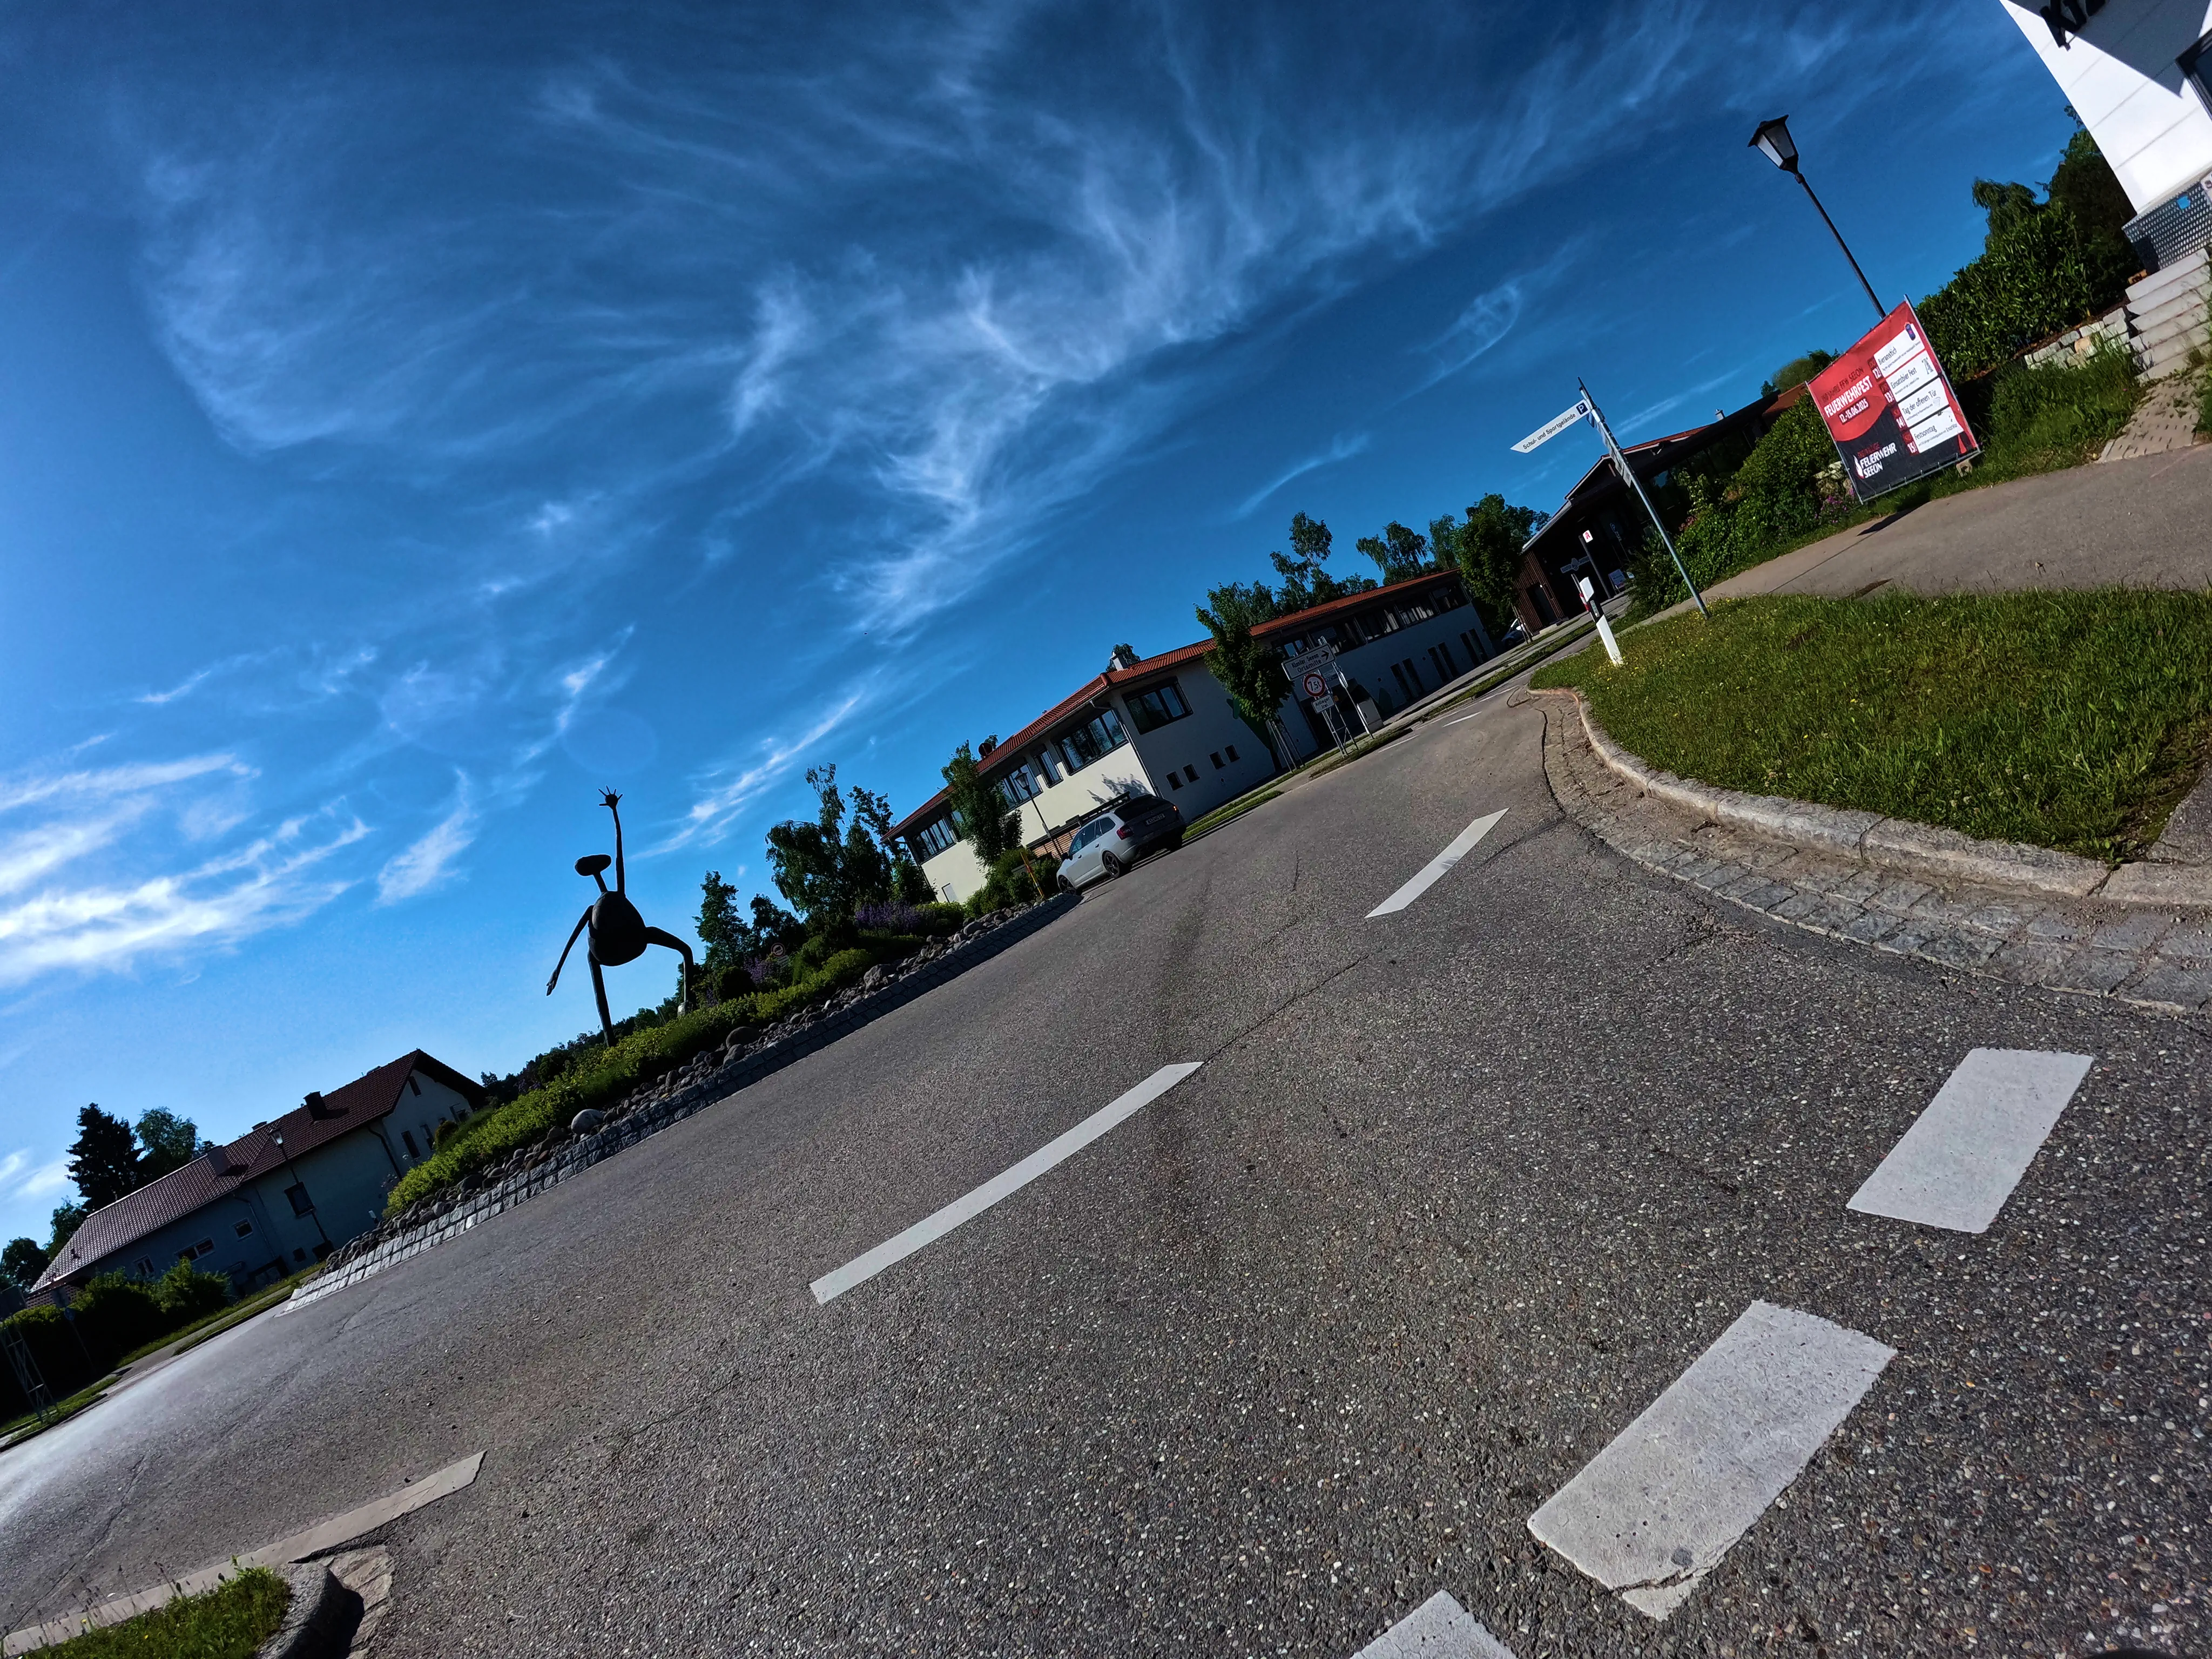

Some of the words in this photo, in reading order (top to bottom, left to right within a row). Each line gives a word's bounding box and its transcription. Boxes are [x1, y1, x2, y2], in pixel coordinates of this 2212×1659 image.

[1849, 366, 1864, 382] SEEON
[1890, 371, 1909, 388] Einsatzbier
[1908, 367, 1917, 376] Fest
[1824, 375, 1873, 417] FEUERWEHRFEST
[1916, 395, 1930, 406] offenen
[1928, 389, 1937, 398] Tür
[1839, 397, 1869, 423] 12.-15.06.2025
[1523, 438, 1537, 449] Schul-
[1537, 432, 1546, 441] und
[1546, 413, 1576, 435] Sportgelände
[1914, 425, 1937, 440] Festsonntag
[1859, 442, 1897, 468] FEUERWEHR
[1862, 461, 1883, 478] SEEON
[1292, 658, 1306, 669] Kloster
[1306, 653, 1319, 662] Seeon
[1297, 659, 1322, 673] Ortsmitte
[1315, 697, 1331, 707] Anlieger
